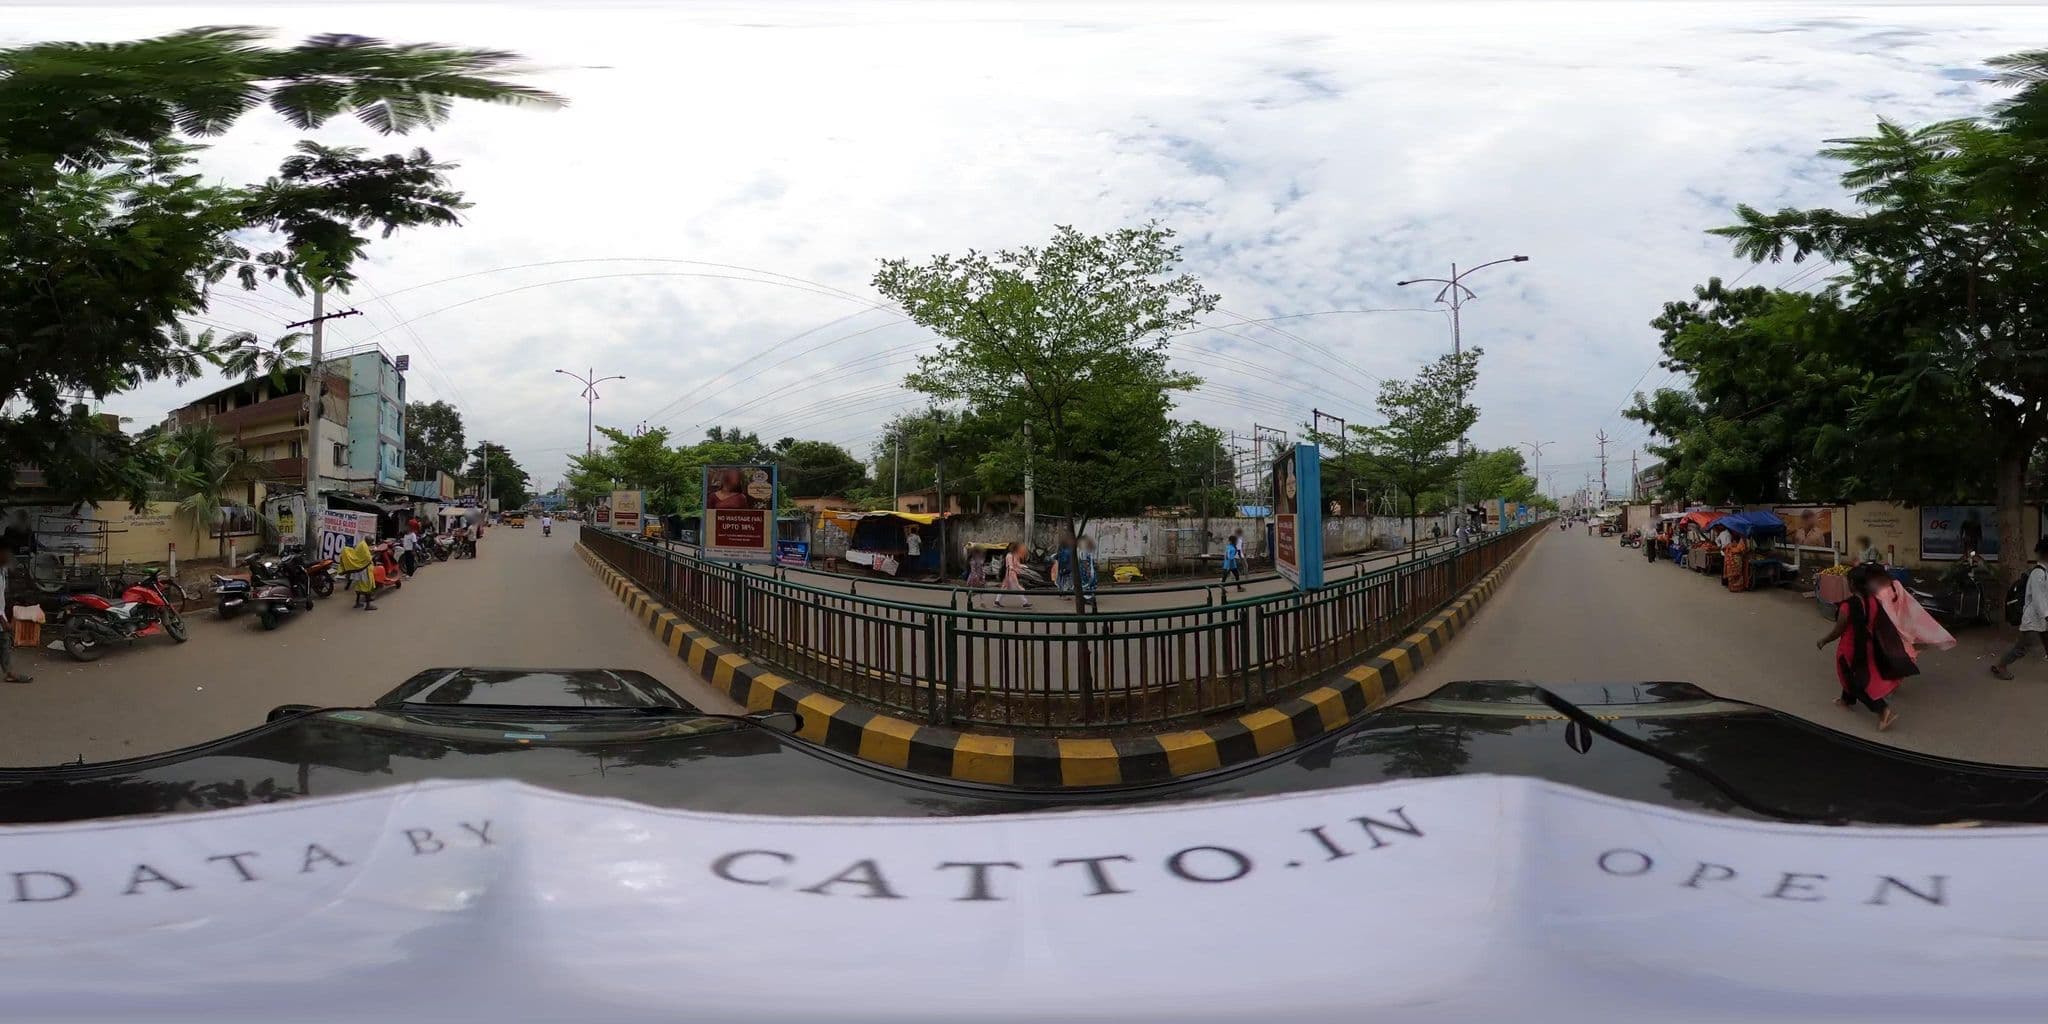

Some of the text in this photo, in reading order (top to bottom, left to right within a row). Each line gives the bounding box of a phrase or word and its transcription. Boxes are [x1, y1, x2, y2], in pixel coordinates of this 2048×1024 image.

[722, 523, 740, 531] UPTO
[8, 819, 494, 902] DATA BY
[1597, 847, 1953, 906] OPEN
